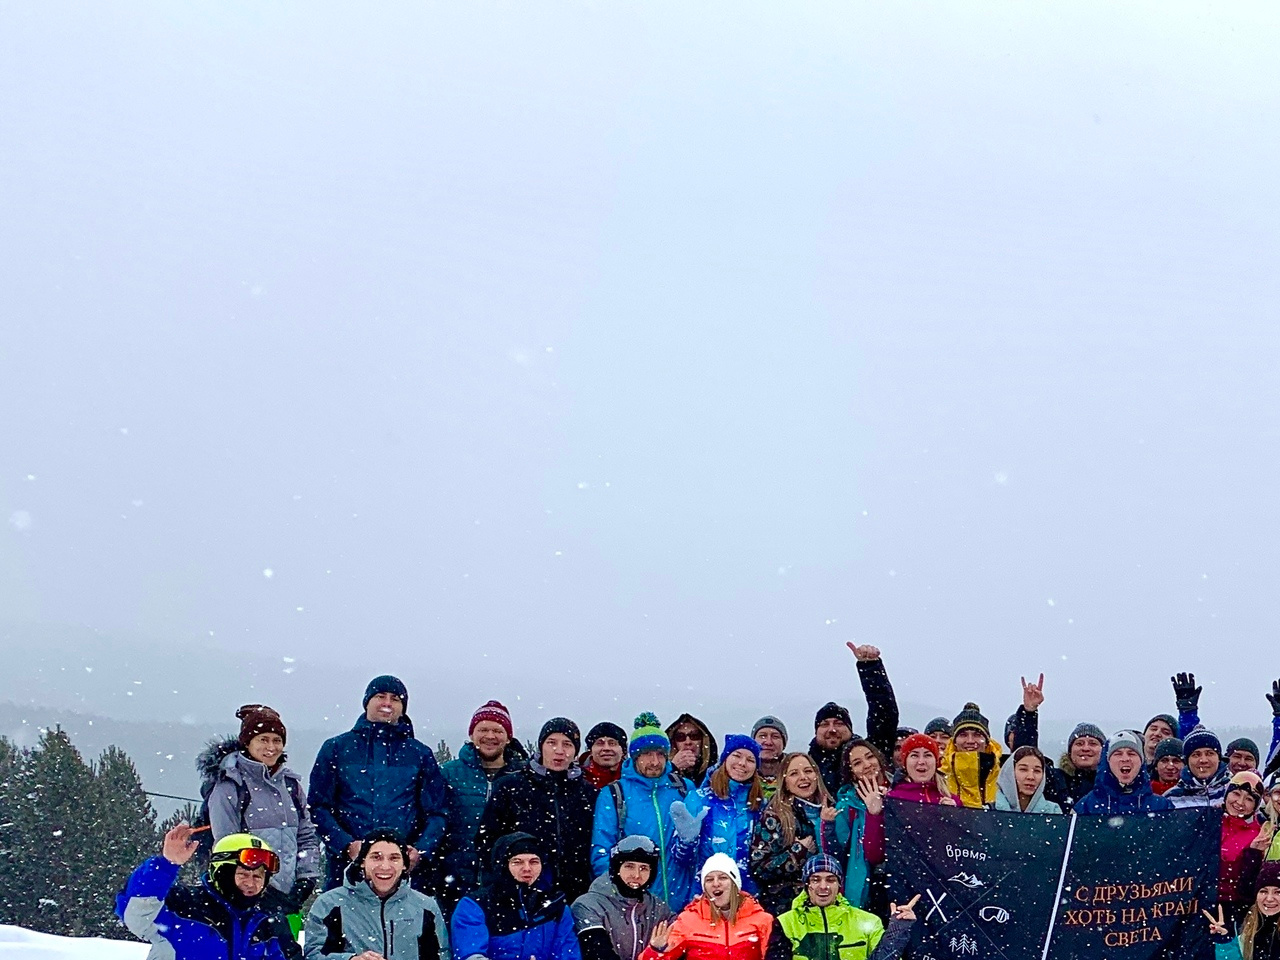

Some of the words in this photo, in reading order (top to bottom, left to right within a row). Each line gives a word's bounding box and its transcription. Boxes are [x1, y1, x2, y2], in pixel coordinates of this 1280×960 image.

[1075, 885, 1090, 902] С
[1092, 876, 1194, 905] ДРУЗЬЯМИ
[1064, 909, 1117, 925] ХОТЬ
[1121, 907, 1149, 924] НА
[1104, 926, 1163, 947] СВЕТА
